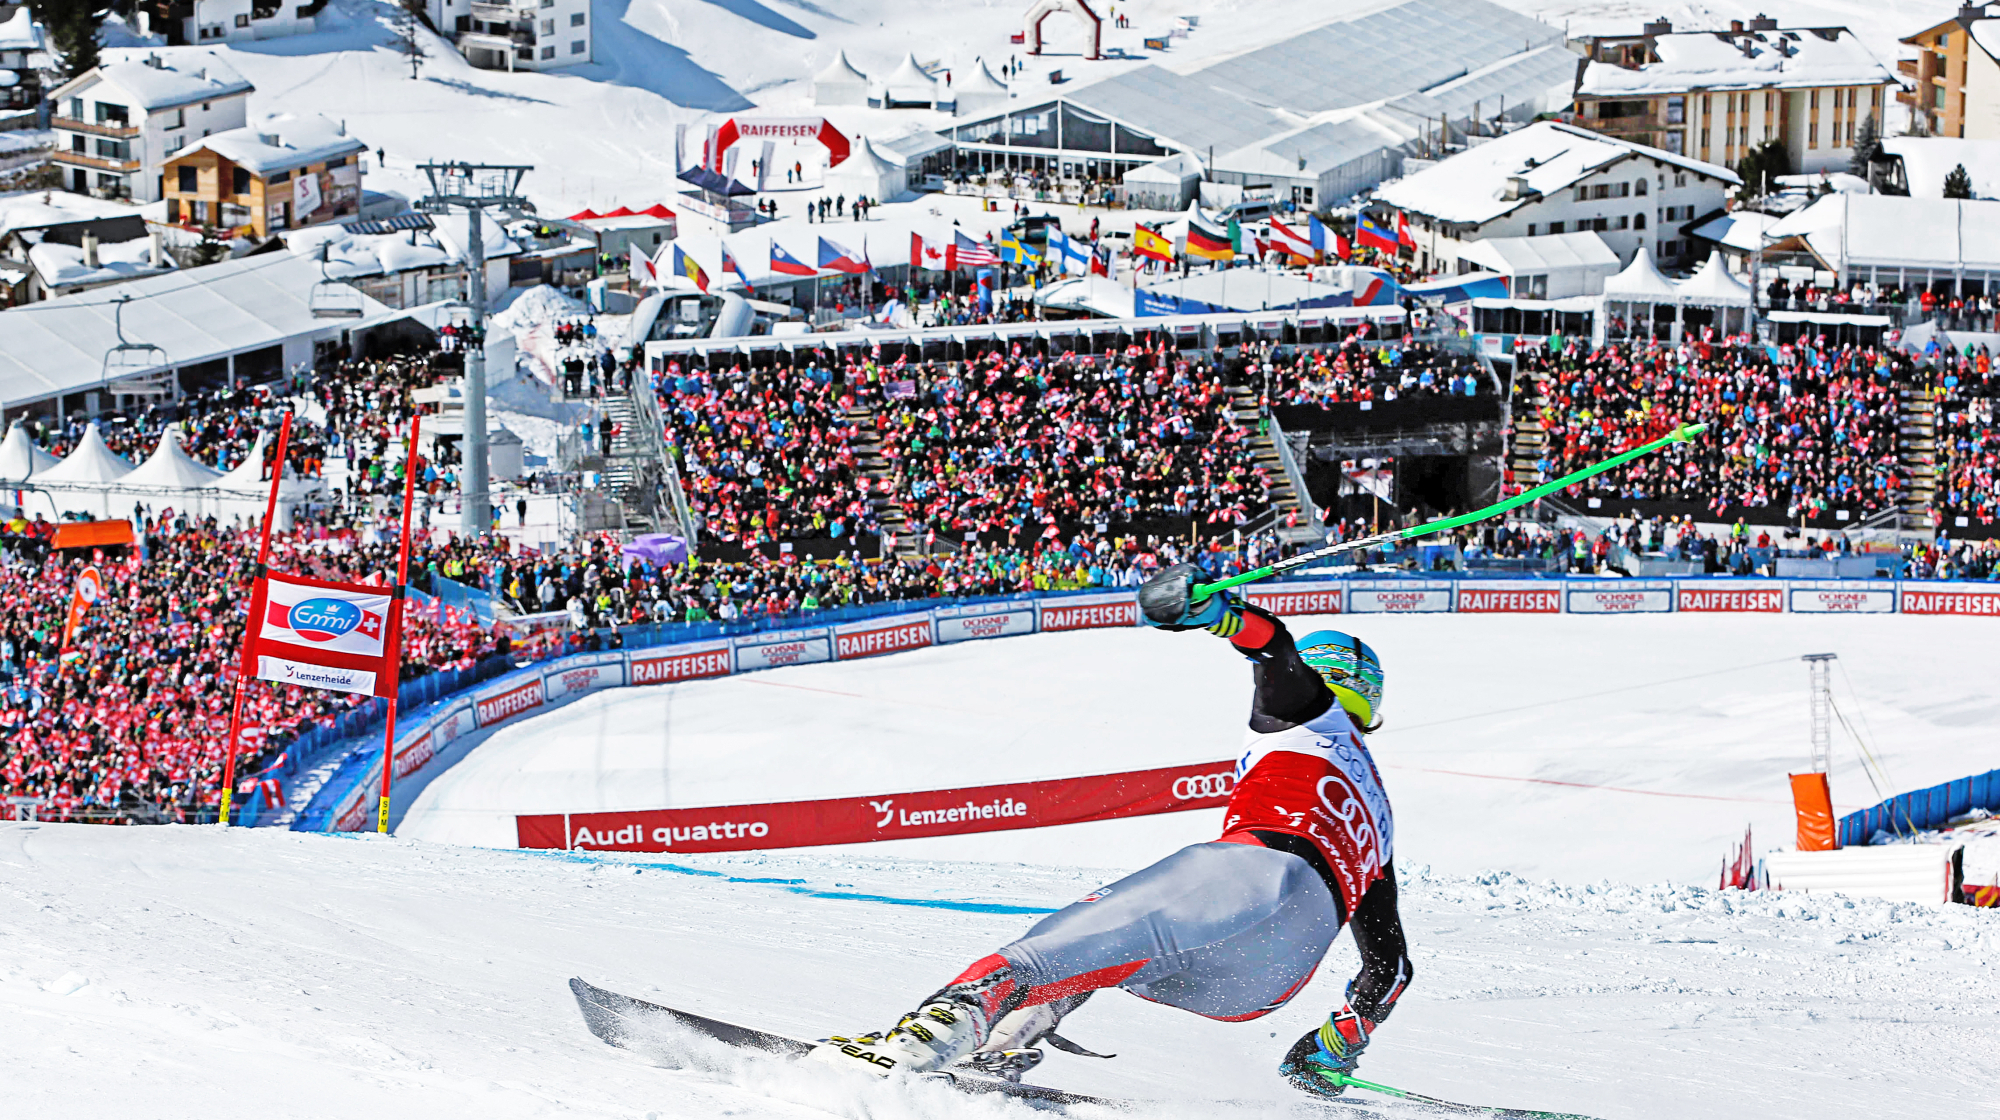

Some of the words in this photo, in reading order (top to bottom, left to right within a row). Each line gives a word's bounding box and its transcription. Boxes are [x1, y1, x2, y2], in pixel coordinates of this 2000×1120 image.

[741, 124, 817, 136] RAIFFEISEN
[1377, 593, 1424, 602] OCHSNER
[1459, 592, 1559, 610] RAIFFEISEN
[1595, 593, 1644, 602] OCHSNER
[1680, 592, 1781, 610] RAIFFEISEN
[1818, 592, 1867, 602] OCHSNER
[1385, 602, 1417, 610] SPORT
[1603, 602, 1636, 611] SPORT
[1826, 602, 1859, 611] SPORT
[295, 605, 355, 629] Emmi
[962, 615, 1009, 628] OCHSNER
[1043, 605, 1136, 628] RAIFFEISEN
[971, 625, 1003, 637] SPORT
[839, 625, 930, 656] RAIFFEISEN
[761, 643, 806, 656] OCHSNER
[768, 654, 799, 665] SPORT
[633, 652, 729, 682] RAIFFEISEN
[296, 671, 351, 685] Lenzerheide
[479, 683, 542, 723] RAIFFEISEN
[900, 798, 1027, 827] Lenzerheide
[573, 824, 643, 846] Audi
[652, 821, 769, 846] quattro
[828, 1042, 897, 1070] EAD
